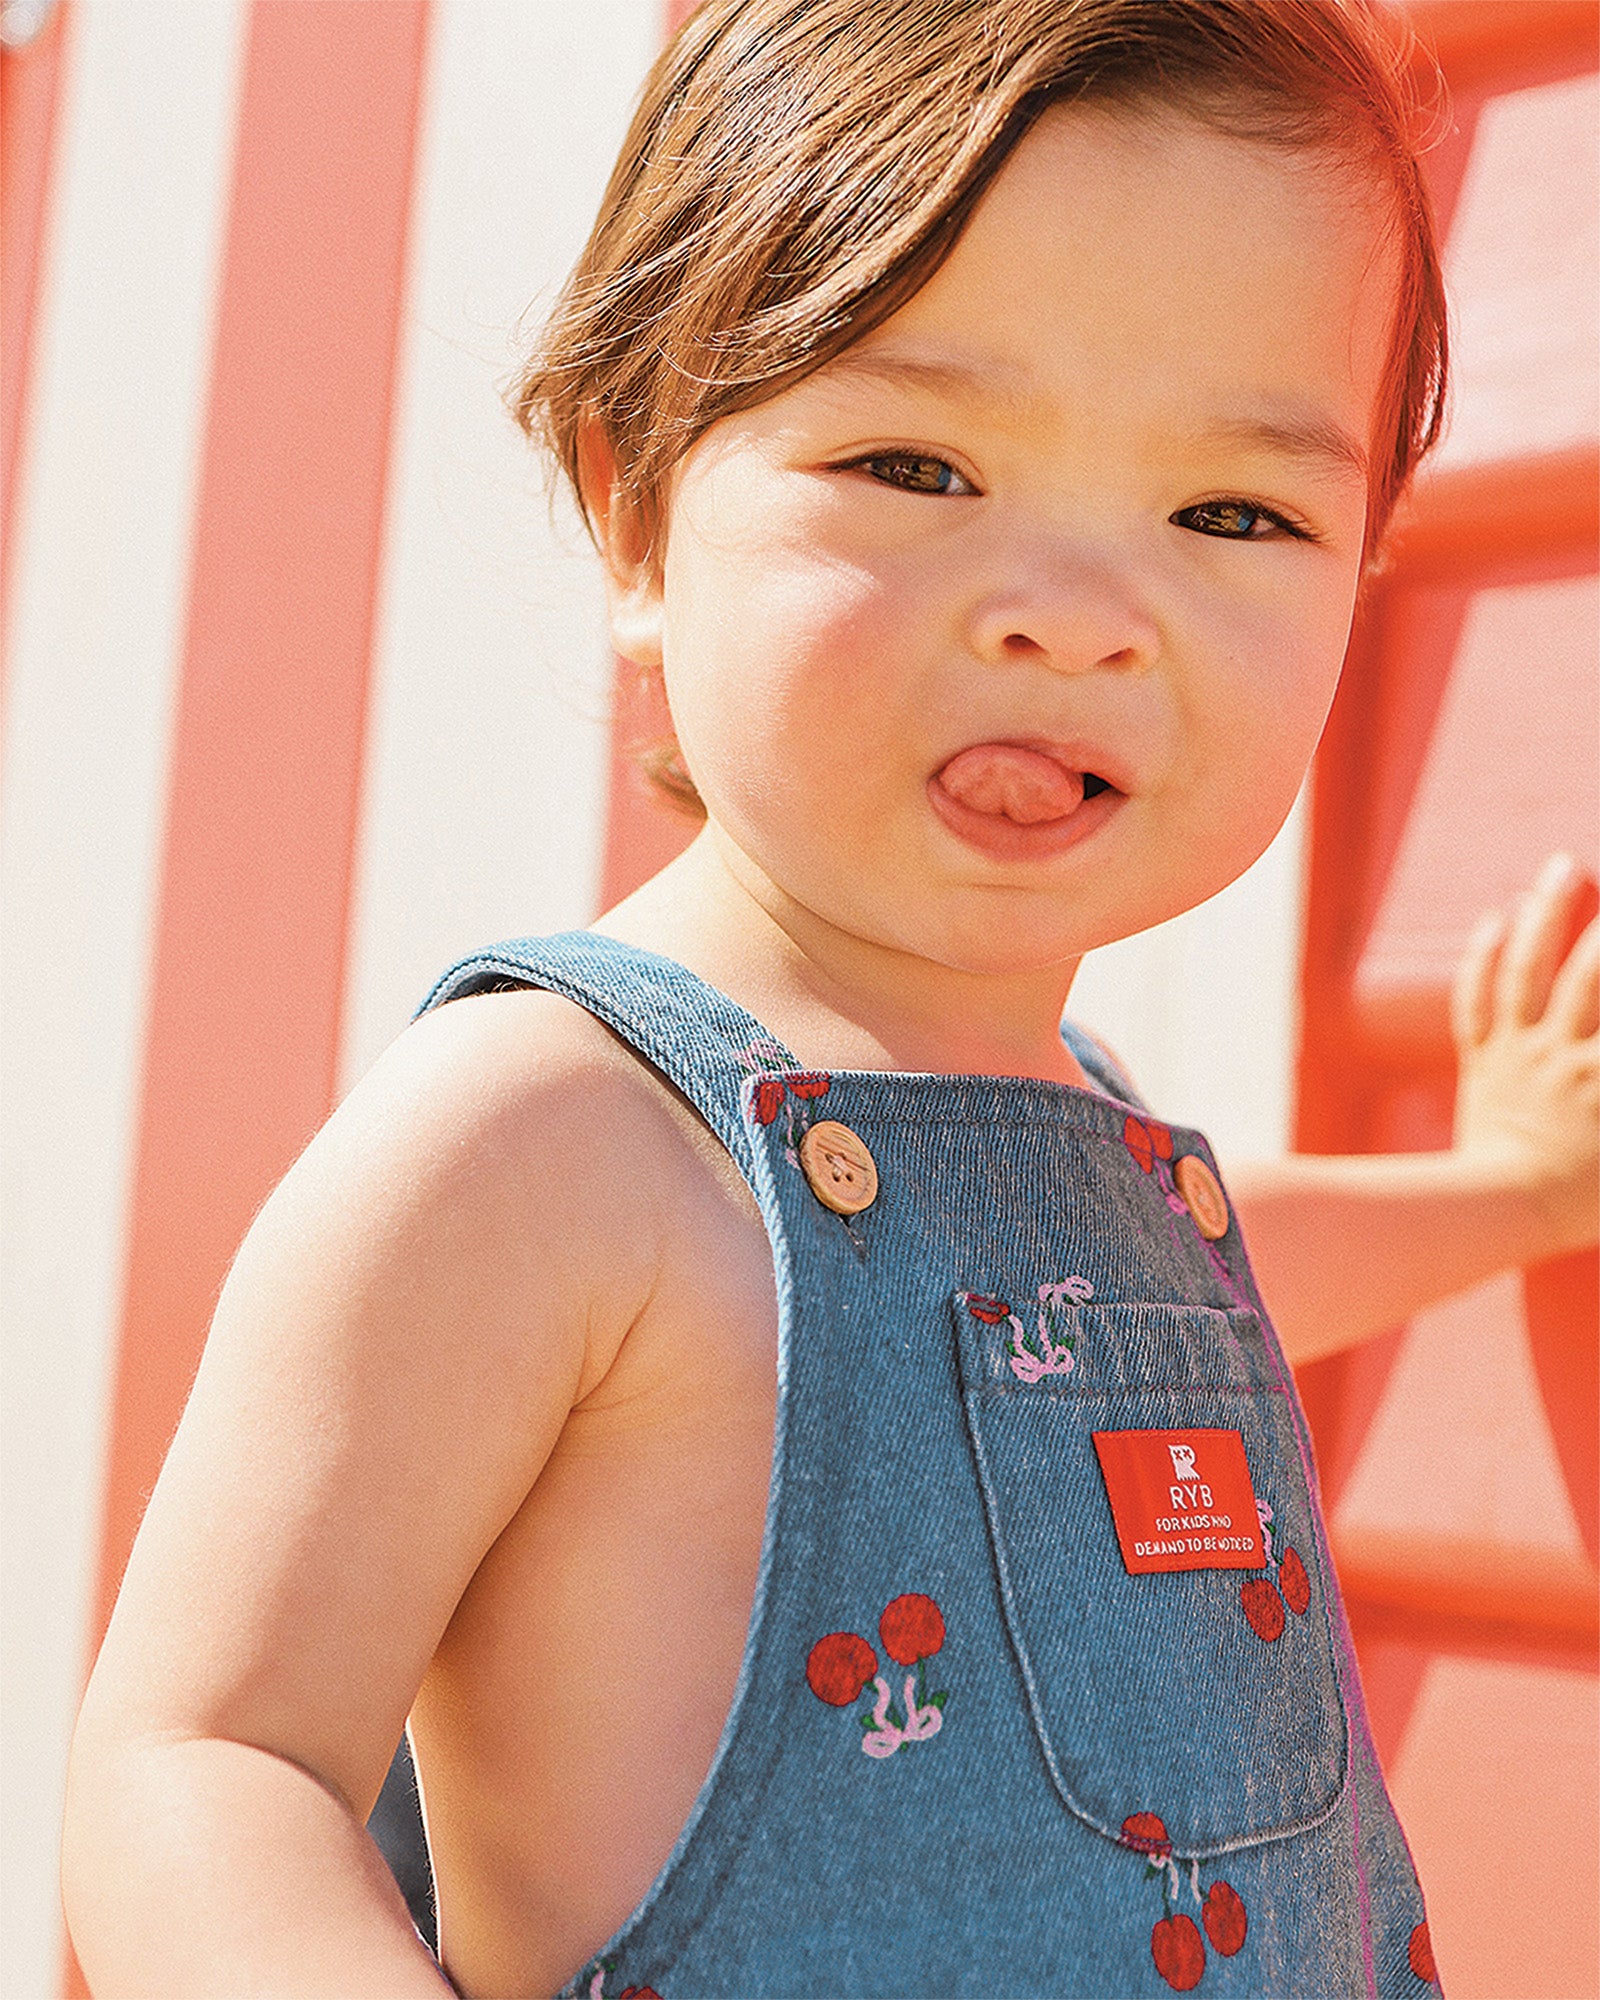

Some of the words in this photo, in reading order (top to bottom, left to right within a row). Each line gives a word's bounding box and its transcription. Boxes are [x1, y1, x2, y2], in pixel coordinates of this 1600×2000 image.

[1169, 1484, 1214, 1510] RYB
[1155, 1517, 1181, 1532] FOR
[1181, 1515, 1211, 1530] KIDS
[1134, 1539, 1186, 1556] DEMAND
[1186, 1538, 1202, 1552] TO
[1203, 1536, 1217, 1551] BE
